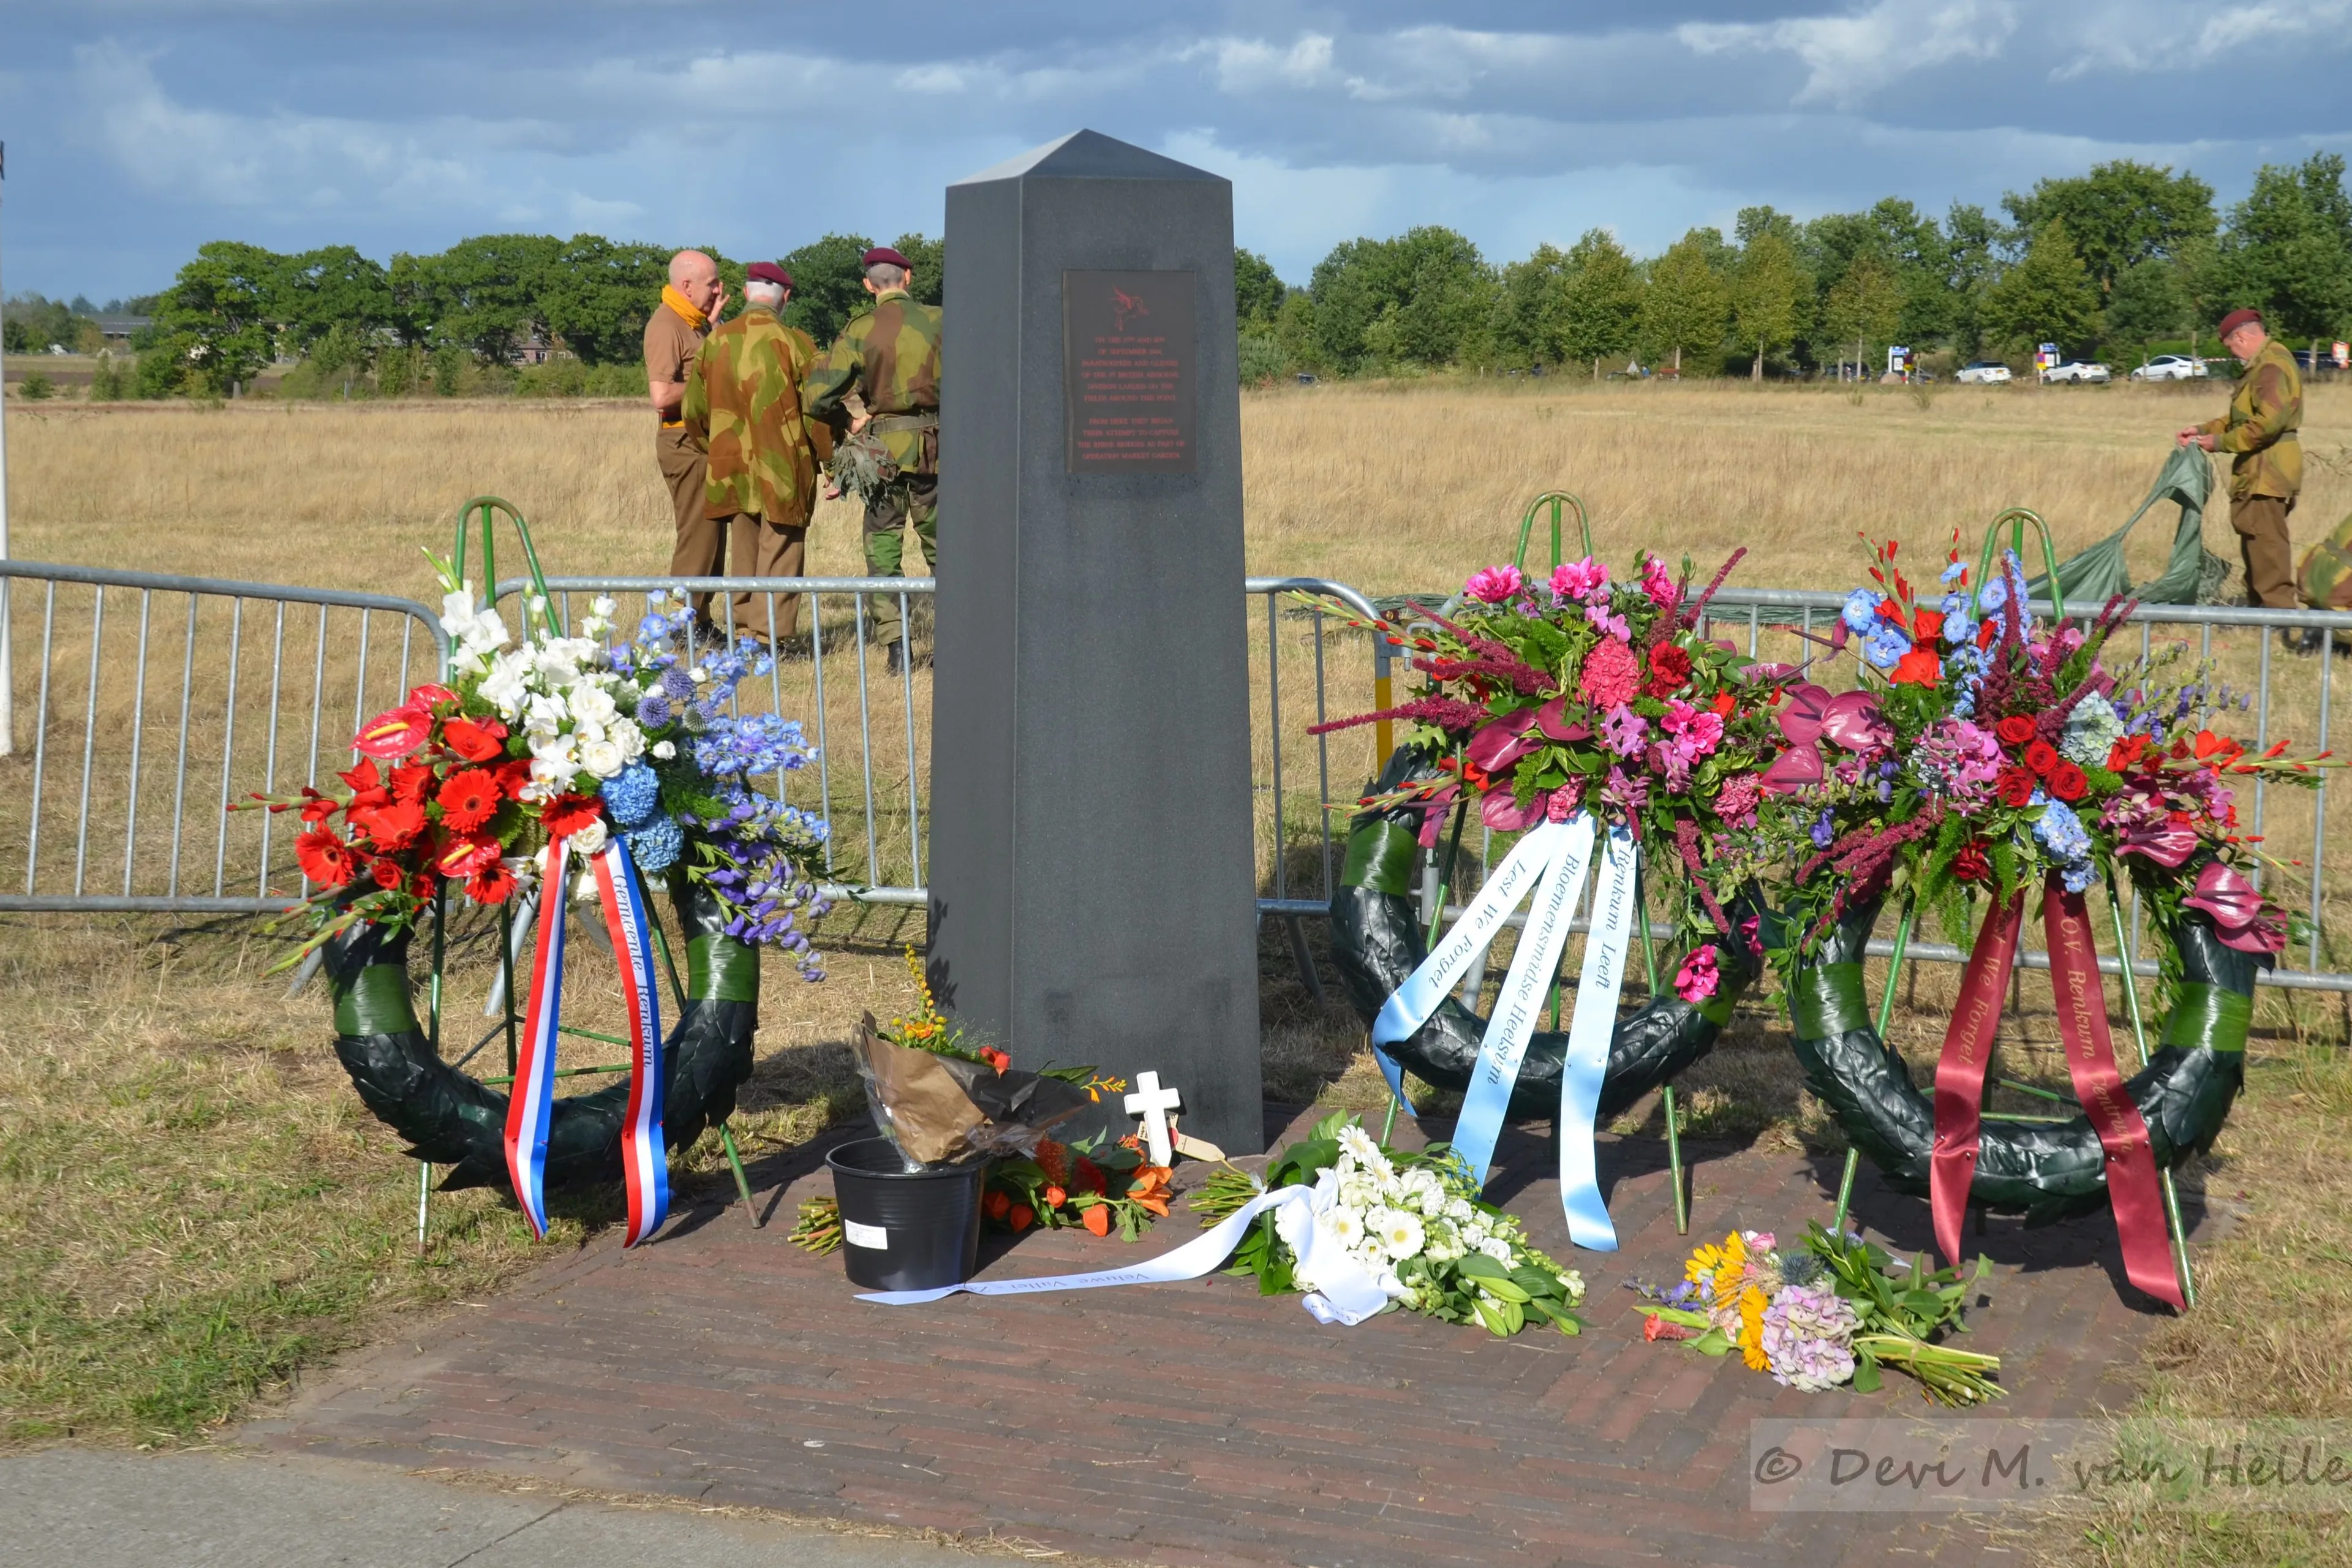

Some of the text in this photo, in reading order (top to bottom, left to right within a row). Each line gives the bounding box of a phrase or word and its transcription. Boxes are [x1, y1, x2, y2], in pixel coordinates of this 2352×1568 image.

[1428, 859, 1527, 989] Lest We Forget
[1605, 847, 1631, 931] Renkum
[612, 874, 654, 1068] Gemeente Renkum
[1487, 852, 1580, 1085] Bloemensmidse Heelsum
[1979, 956, 2001, 987] We
[1958, 997, 1989, 1066] Forget
[2060, 917, 2134, 1153] O.V. Renkum Centrum
[1011, 1280, 1067, 1291] Vallei
[1079, 1272, 1150, 1284] Veluwe
